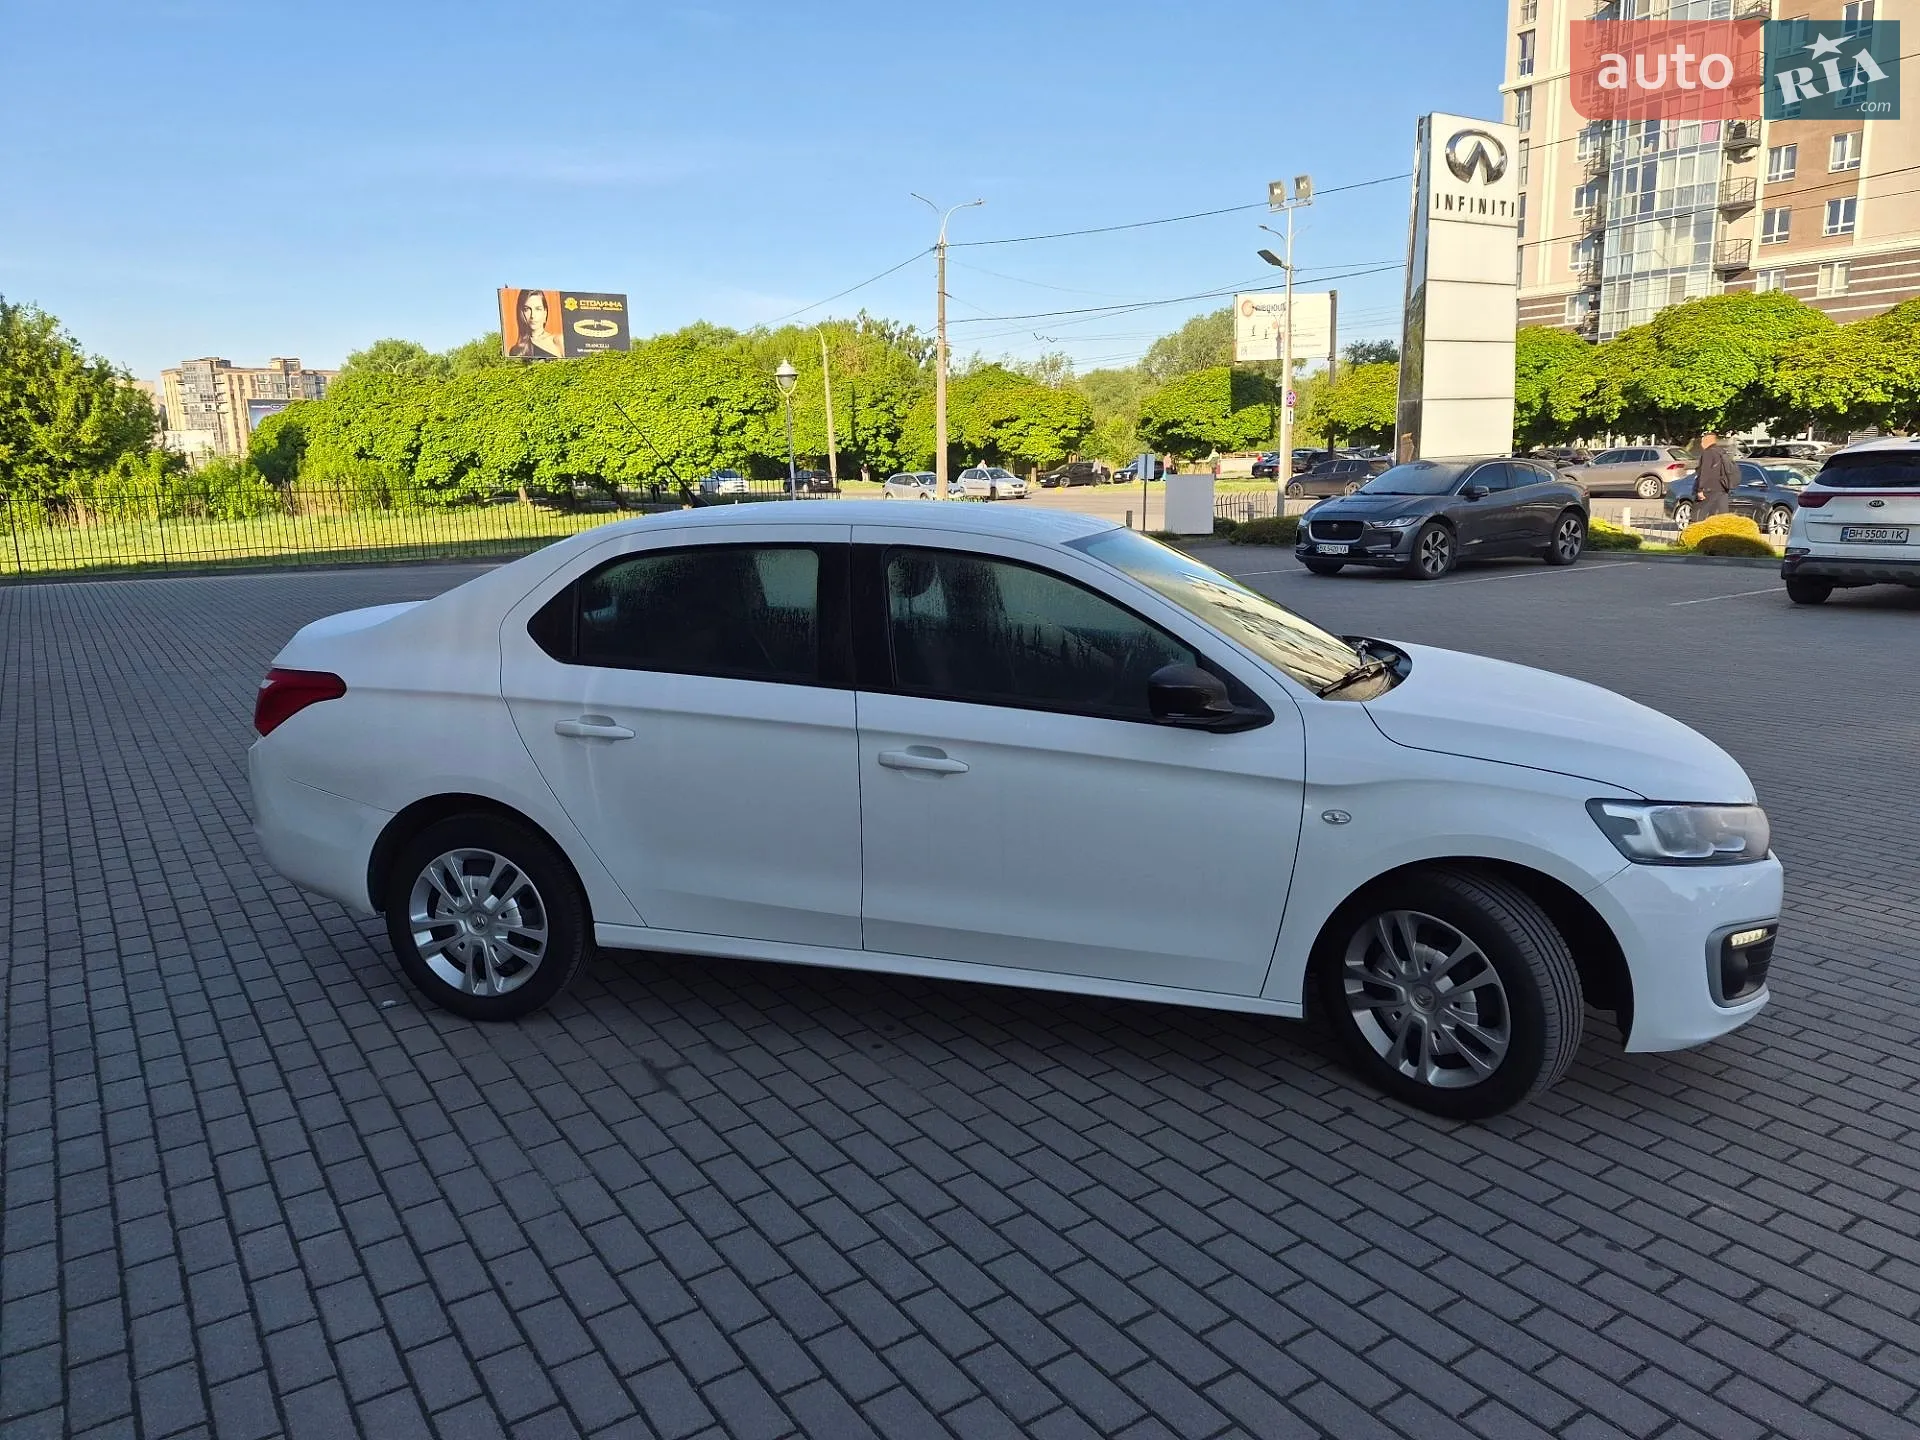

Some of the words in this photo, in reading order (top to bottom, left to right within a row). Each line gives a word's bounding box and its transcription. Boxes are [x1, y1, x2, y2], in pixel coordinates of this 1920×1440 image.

[1435, 193, 1515, 218] INFINITI
[1849, 529, 1863, 538] BH
[1865, 529, 1887, 539] 5500
[1891, 530, 1905, 540] IK
